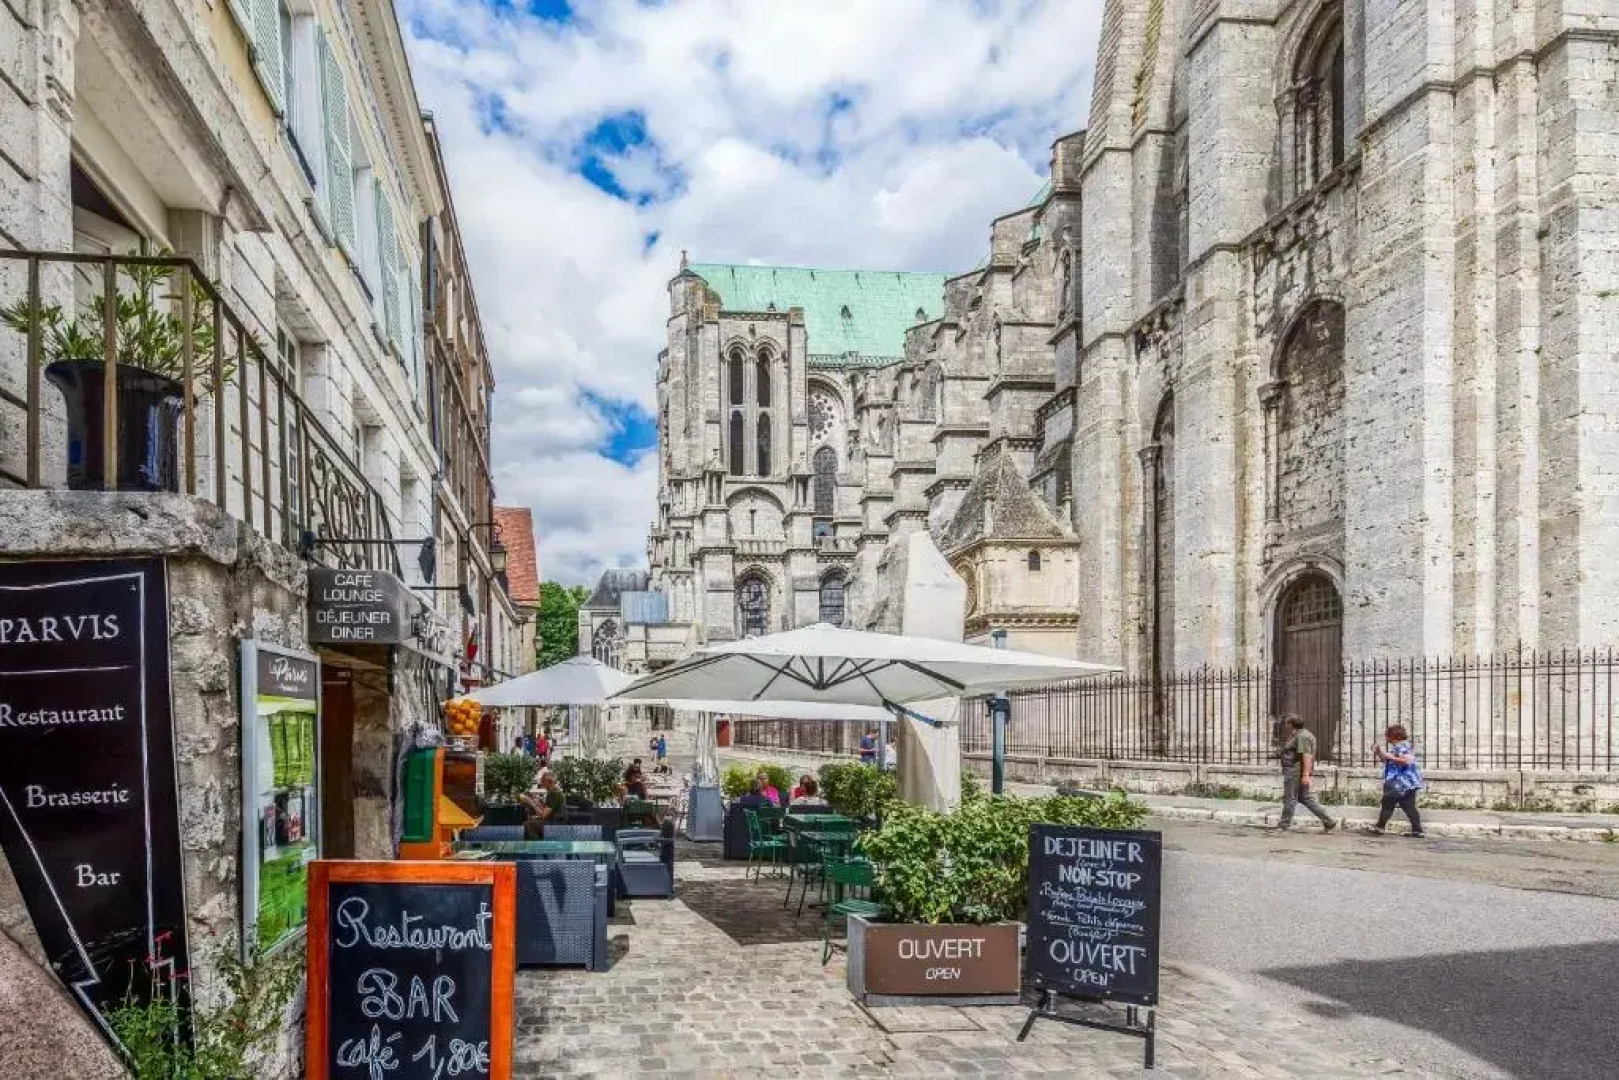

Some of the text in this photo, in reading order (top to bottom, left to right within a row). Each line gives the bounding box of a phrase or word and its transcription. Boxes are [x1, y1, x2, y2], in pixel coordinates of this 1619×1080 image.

[323, 588, 384, 602] LOUNGE
[0, 614, 120, 643] PARVIS
[316, 608, 390, 624] DÉJEUNER
[0, 703, 125, 727] Restaurant
[25, 783, 129, 808] Brasserie
[1044, 836, 1144, 863] DEJEUNER
[75, 864, 121, 888] Bar
[1058, 864, 1141, 890] NON-STOP
[336, 896, 493, 950] Restaurant
[898, 938, 986, 959] OUVERT
[925, 967, 961, 980] OPEN
[357, 968, 460, 1023] BAR
[336, 1023, 491, 1080] café 1,80€
